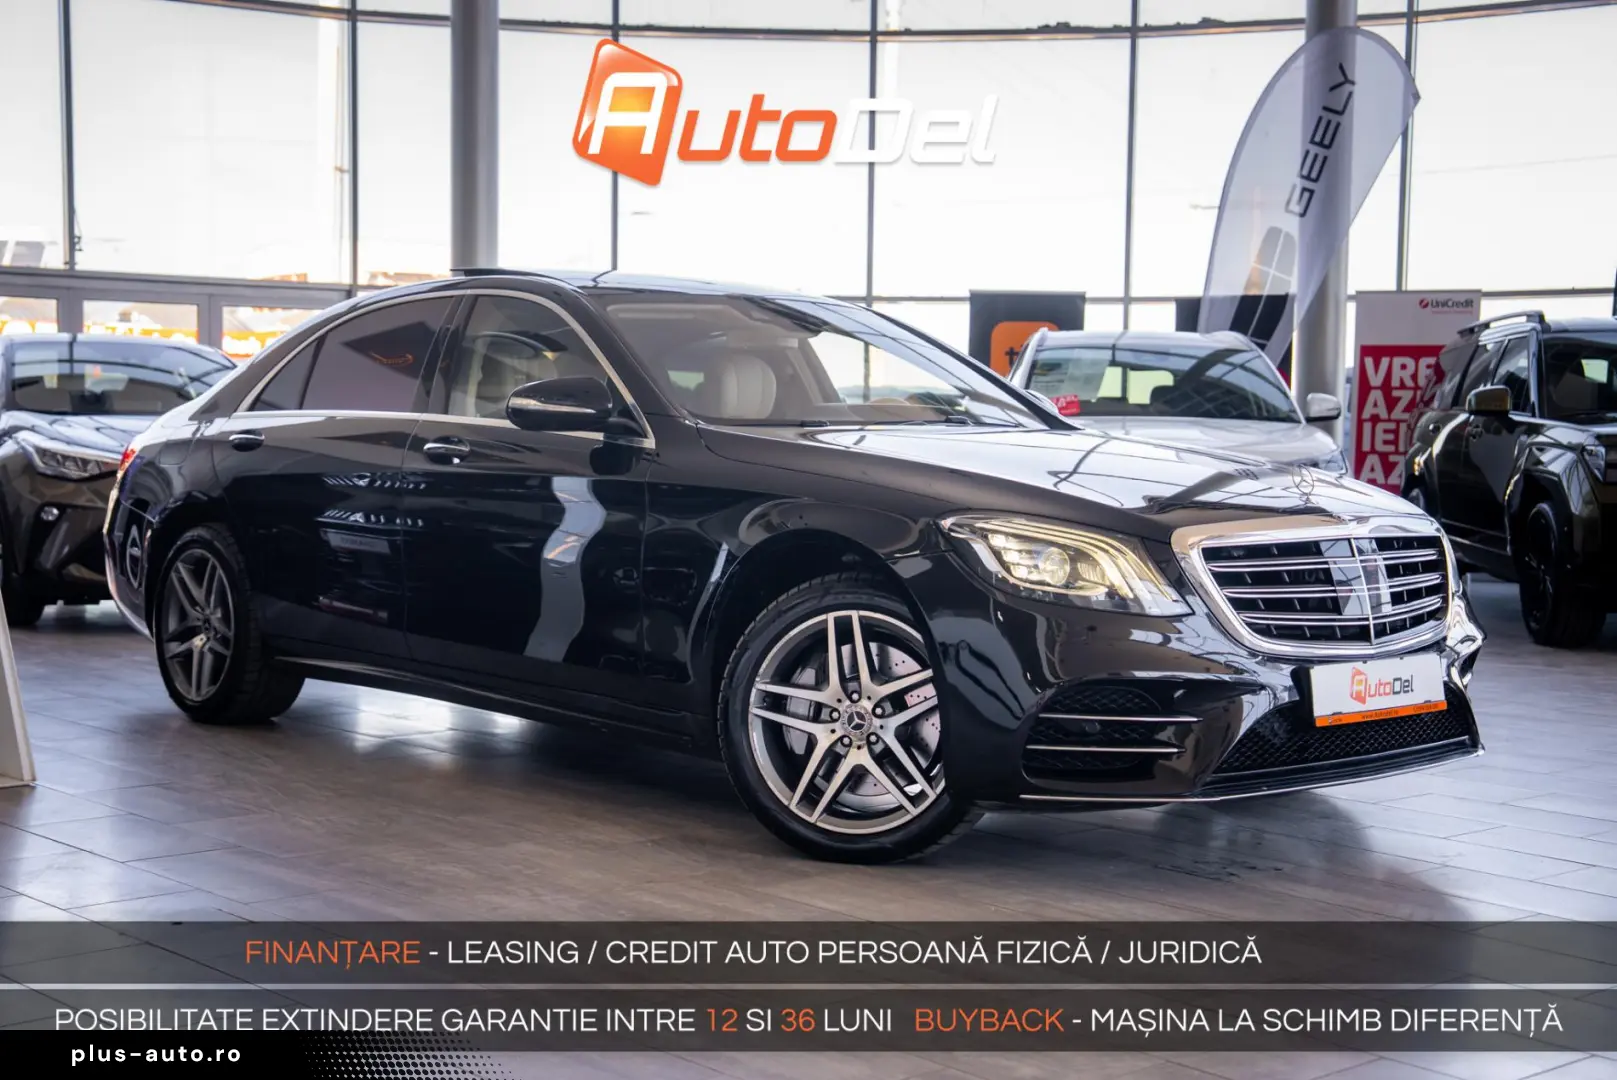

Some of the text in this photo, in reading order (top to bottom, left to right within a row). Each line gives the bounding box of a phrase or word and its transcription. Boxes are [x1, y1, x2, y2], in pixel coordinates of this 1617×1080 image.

[1284, 61, 1357, 219] GEELY
[1430, 298, 1474, 309] UniCredit
[1352, 672, 1414, 699] AutoDel
